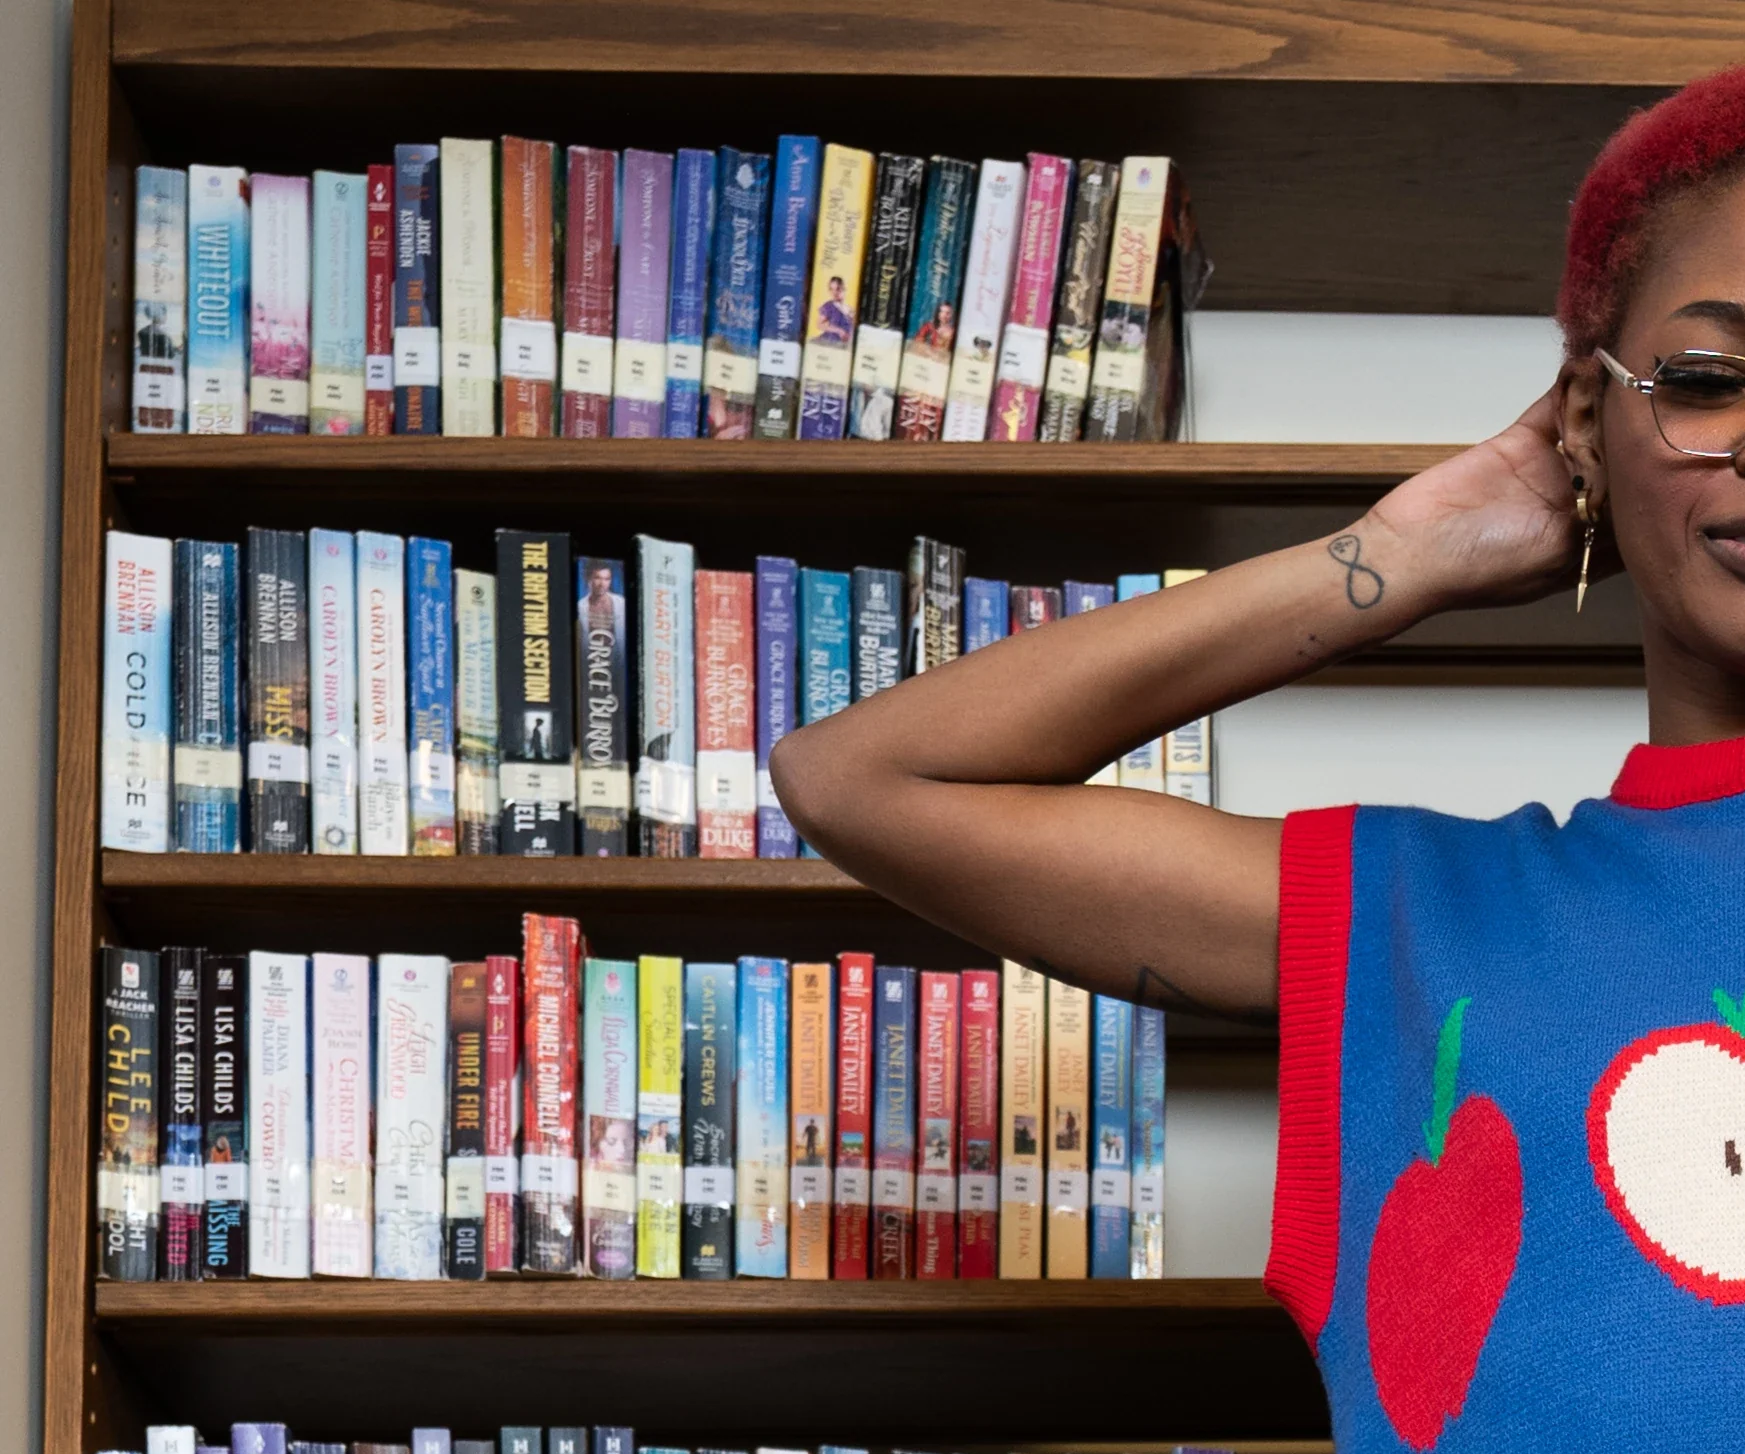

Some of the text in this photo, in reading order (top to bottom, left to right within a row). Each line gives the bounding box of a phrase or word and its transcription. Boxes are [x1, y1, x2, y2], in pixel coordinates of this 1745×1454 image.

[195, 224, 231, 340] WHITEOUT
[398, 208, 414, 268] ASHENDEN
[415, 217, 431, 256] JACKIE
[116, 560, 139, 637] BRENNAN
[136, 567, 157, 634] ALLISON
[257, 572, 278, 646] BRENNAN
[277, 578, 298, 643] ALLISON
[523, 542, 550, 703] THE RHYTHM SECTION
[126, 651, 148, 732] COLD
[369, 588, 388, 744] CAROLYN BROWN
[654, 589, 674, 729] MARY BURTON
[703, 646, 728, 747] BURROWES
[726, 663, 748, 728] GRACE
[107, 1022, 131, 1133] CHILD
[129, 1047, 152, 1114] LEE
[213, 1006, 235, 1115] LISA CHILDS
[456, 1032, 479, 1131] UNDER FIRE
[535, 995, 560, 1137] MICHAEL CONNELLY
[700, 975, 717, 1107] CAITLIN CREWS
[841, 1006, 860, 1117] JANET DAILEY
[455, 1226, 478, 1267] COLE
